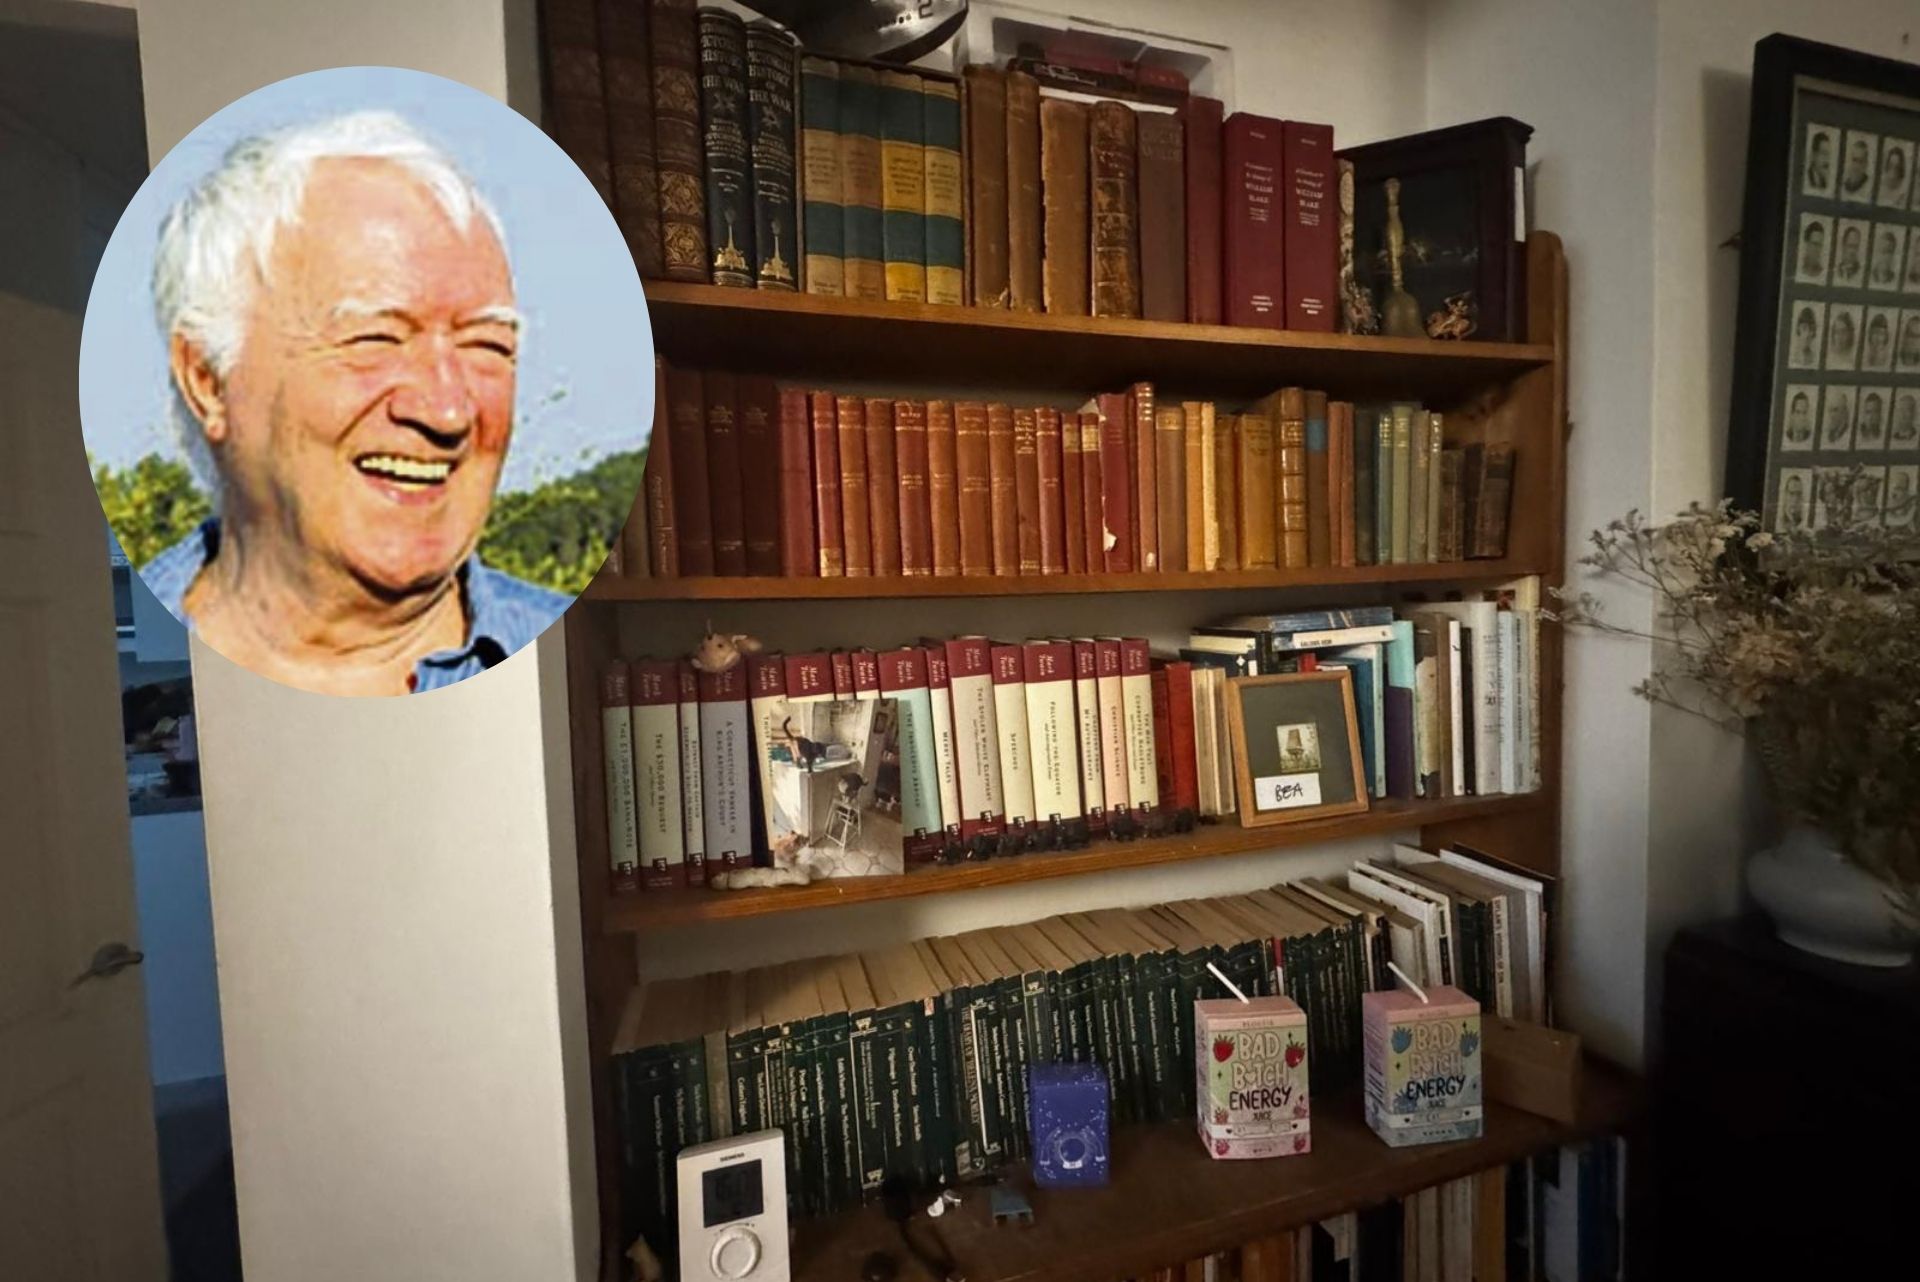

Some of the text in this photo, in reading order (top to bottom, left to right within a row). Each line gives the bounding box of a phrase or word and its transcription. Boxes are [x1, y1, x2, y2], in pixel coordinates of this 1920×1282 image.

[918, 0, 934, 18] 2
[1295, 188, 1323, 199] WILLIAM
[859, 662, 868, 684] Twain
[867, 663, 875, 681] Mark
[1000, 656, 1009, 678] Twain
[1008, 656, 1016, 675] Mark
[1038, 654, 1047, 676] Twain
[1045, 655, 1054, 674] Mark
[801, 666, 810, 690] Twain
[809, 667, 818, 686] Mark
[976, 687, 984, 702] THE
[978, 705, 987, 733] STOLEN
[1049, 701, 1057, 744] FOLLOWING
[727, 730, 735, 787] CONNECTICUT
[1274, 783, 1303, 802] BEA
[1237, 1031, 1281, 1060] BAD
[1414, 1022, 1458, 1051] BAD
[1229, 1086, 1292, 1110] ENERGY
[1407, 1076, 1466, 1101] ENERGY
[1253, 1112, 1272, 1121] JUICE
